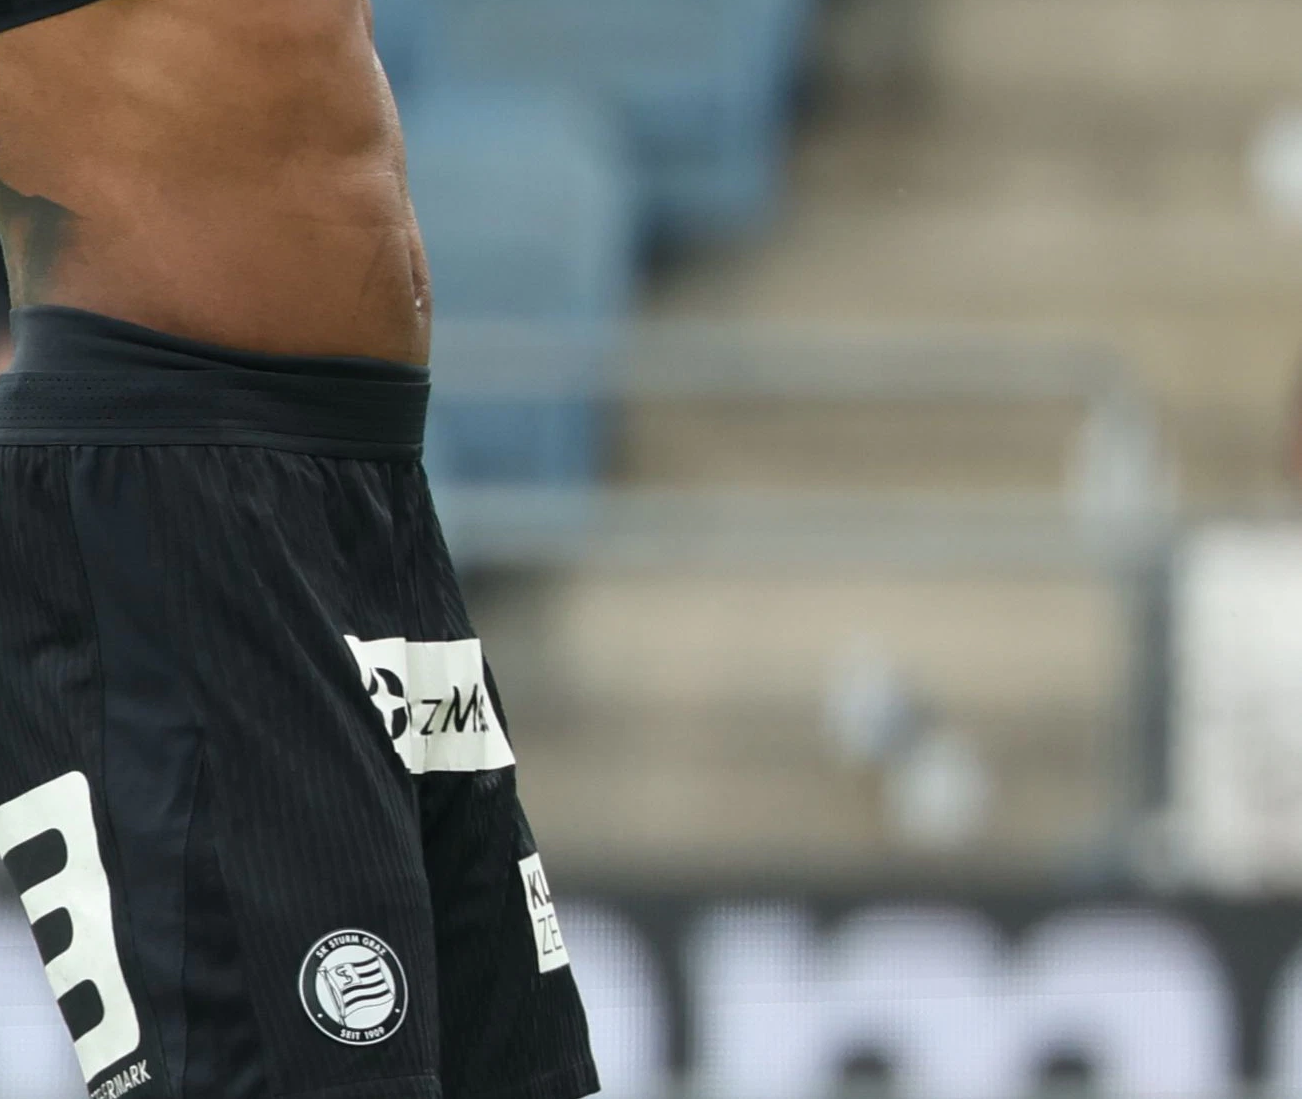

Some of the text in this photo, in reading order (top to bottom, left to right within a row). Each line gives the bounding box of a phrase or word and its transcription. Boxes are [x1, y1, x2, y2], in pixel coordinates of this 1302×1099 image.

[315, 934, 388, 959] SK STURM GRAZ
[339, 1026, 385, 1040] SEIT 1909
